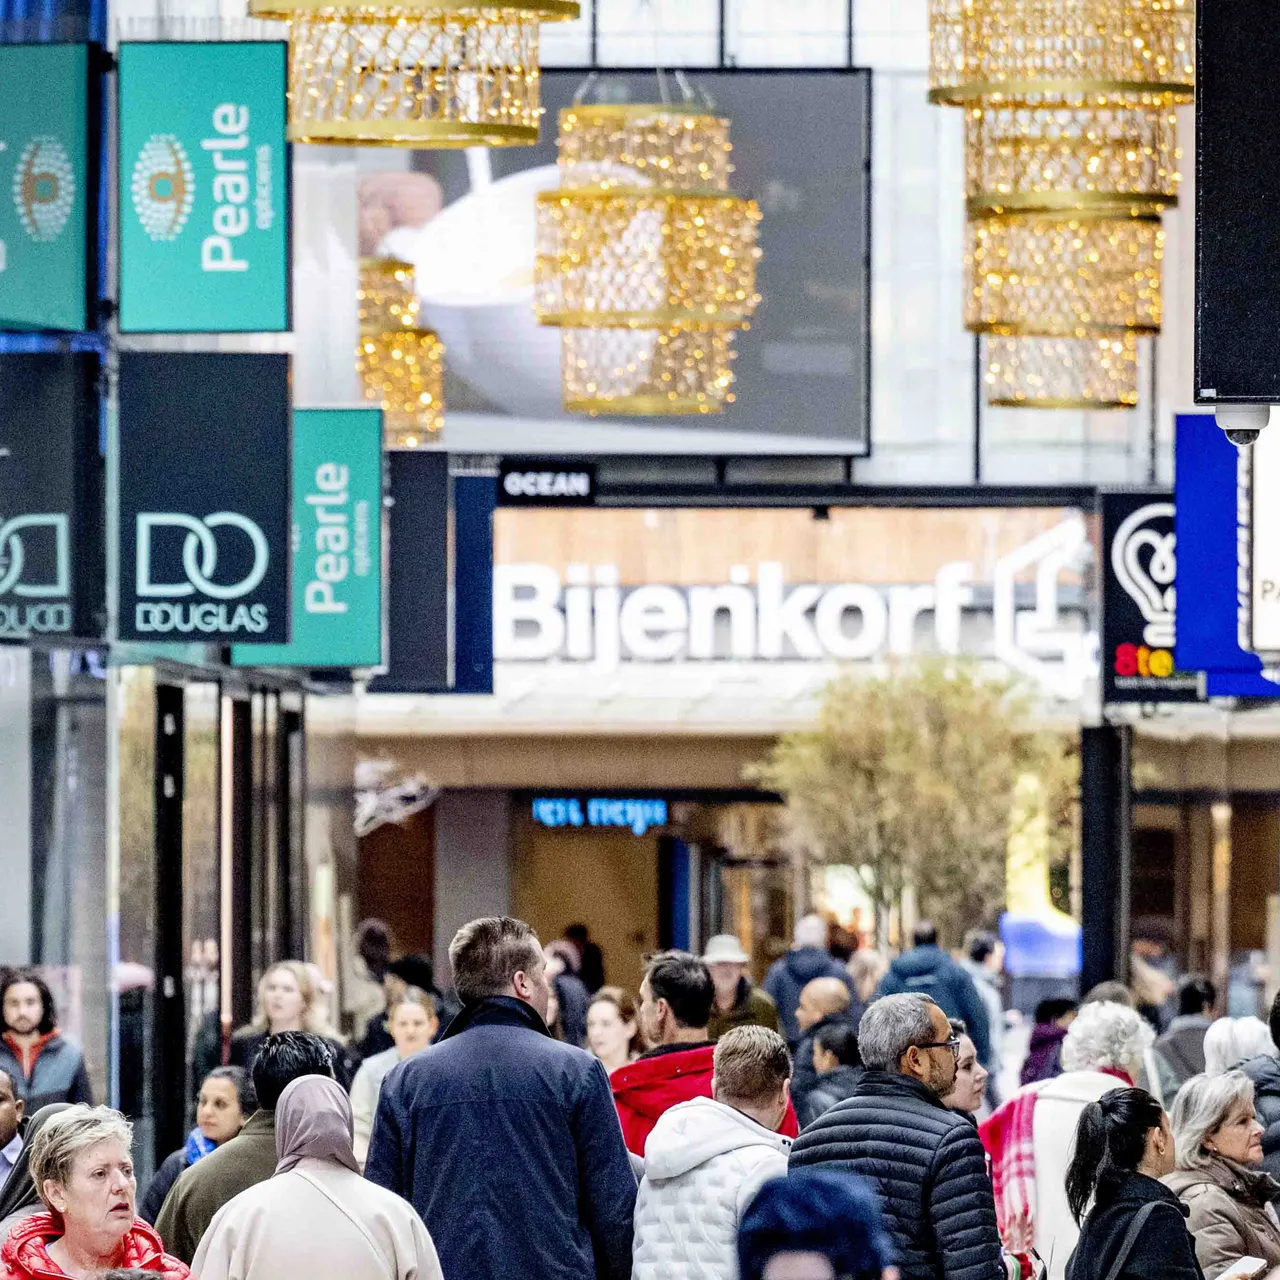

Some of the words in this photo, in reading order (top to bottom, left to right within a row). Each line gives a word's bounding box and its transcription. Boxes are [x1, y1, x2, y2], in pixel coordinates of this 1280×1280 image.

[201, 103, 250, 272] Pearle
[304, 462, 350, 614] Pearle
[503, 472, 590, 497] OCEAN
[136, 602, 268, 633] DOUGLAS
[493, 561, 973, 673] Bijenkorf
